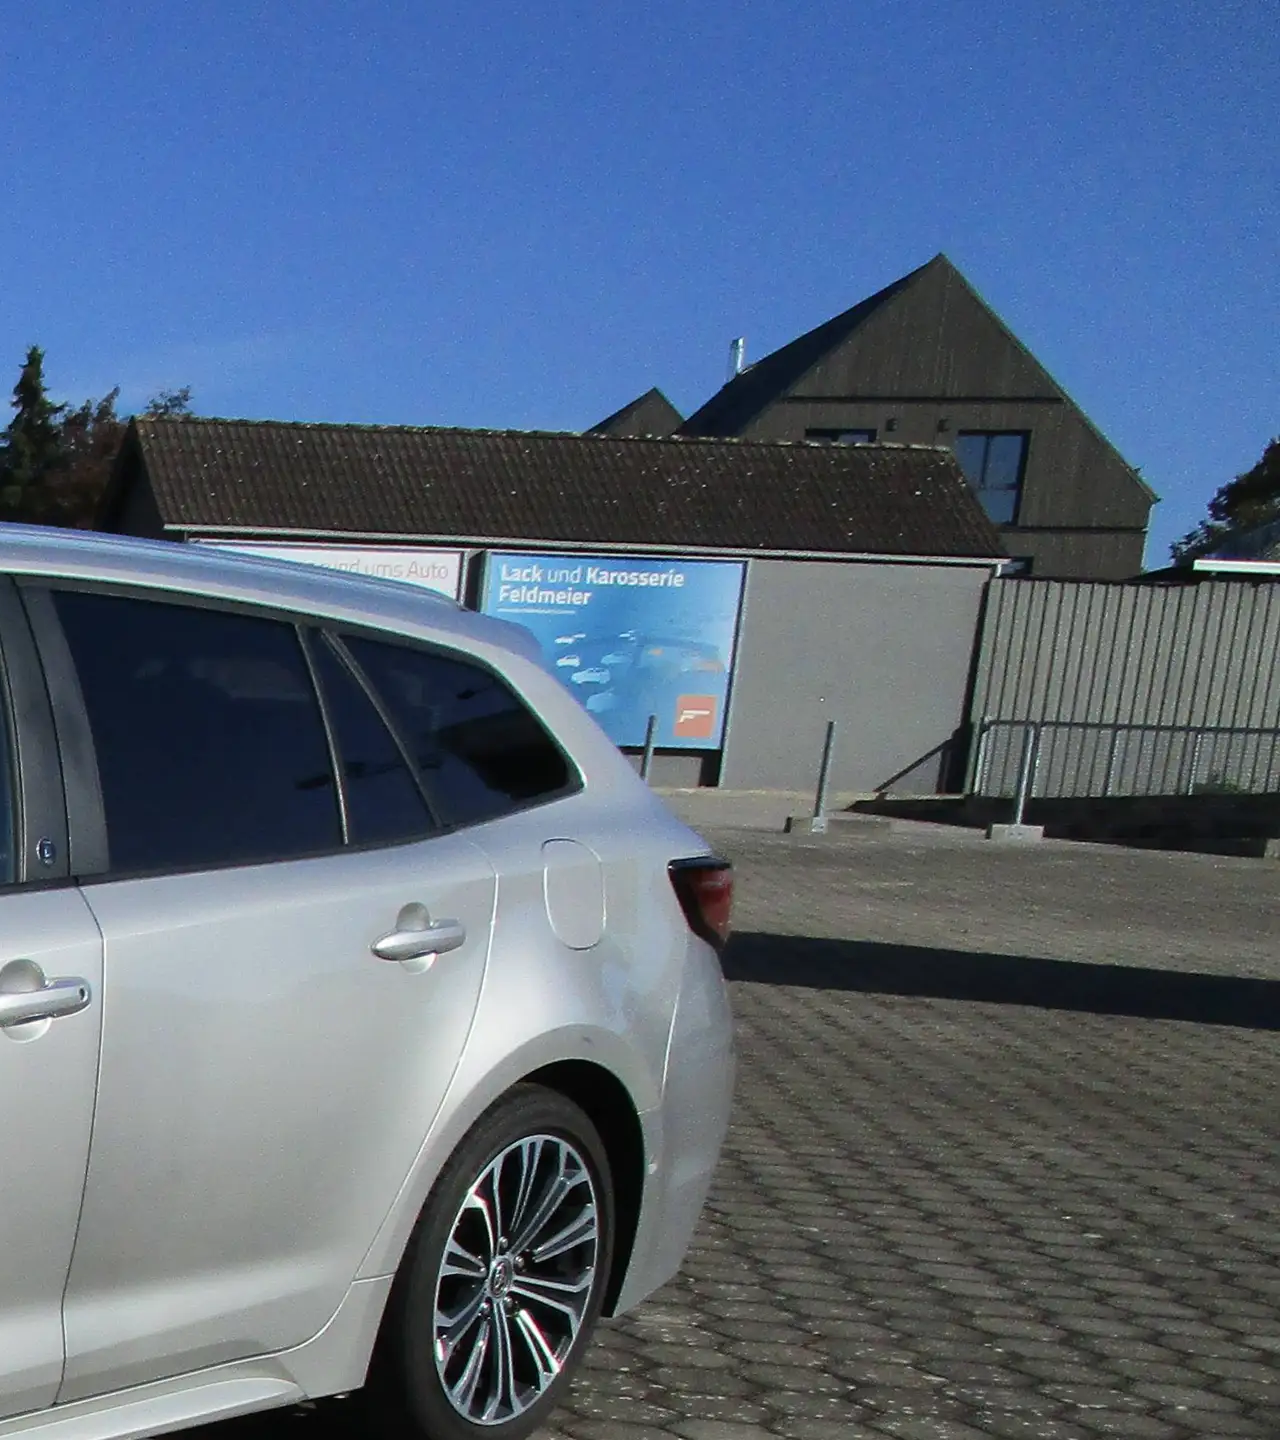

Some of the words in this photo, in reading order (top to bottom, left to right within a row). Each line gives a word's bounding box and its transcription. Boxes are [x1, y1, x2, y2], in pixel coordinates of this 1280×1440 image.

[364, 563, 404, 578] ums
[406, 560, 449, 580] Auto
[500, 564, 542, 583] Lack
[547, 565, 581, 584] und
[586, 566, 685, 588] Karosserie
[499, 585, 592, 605] Feldmeier
